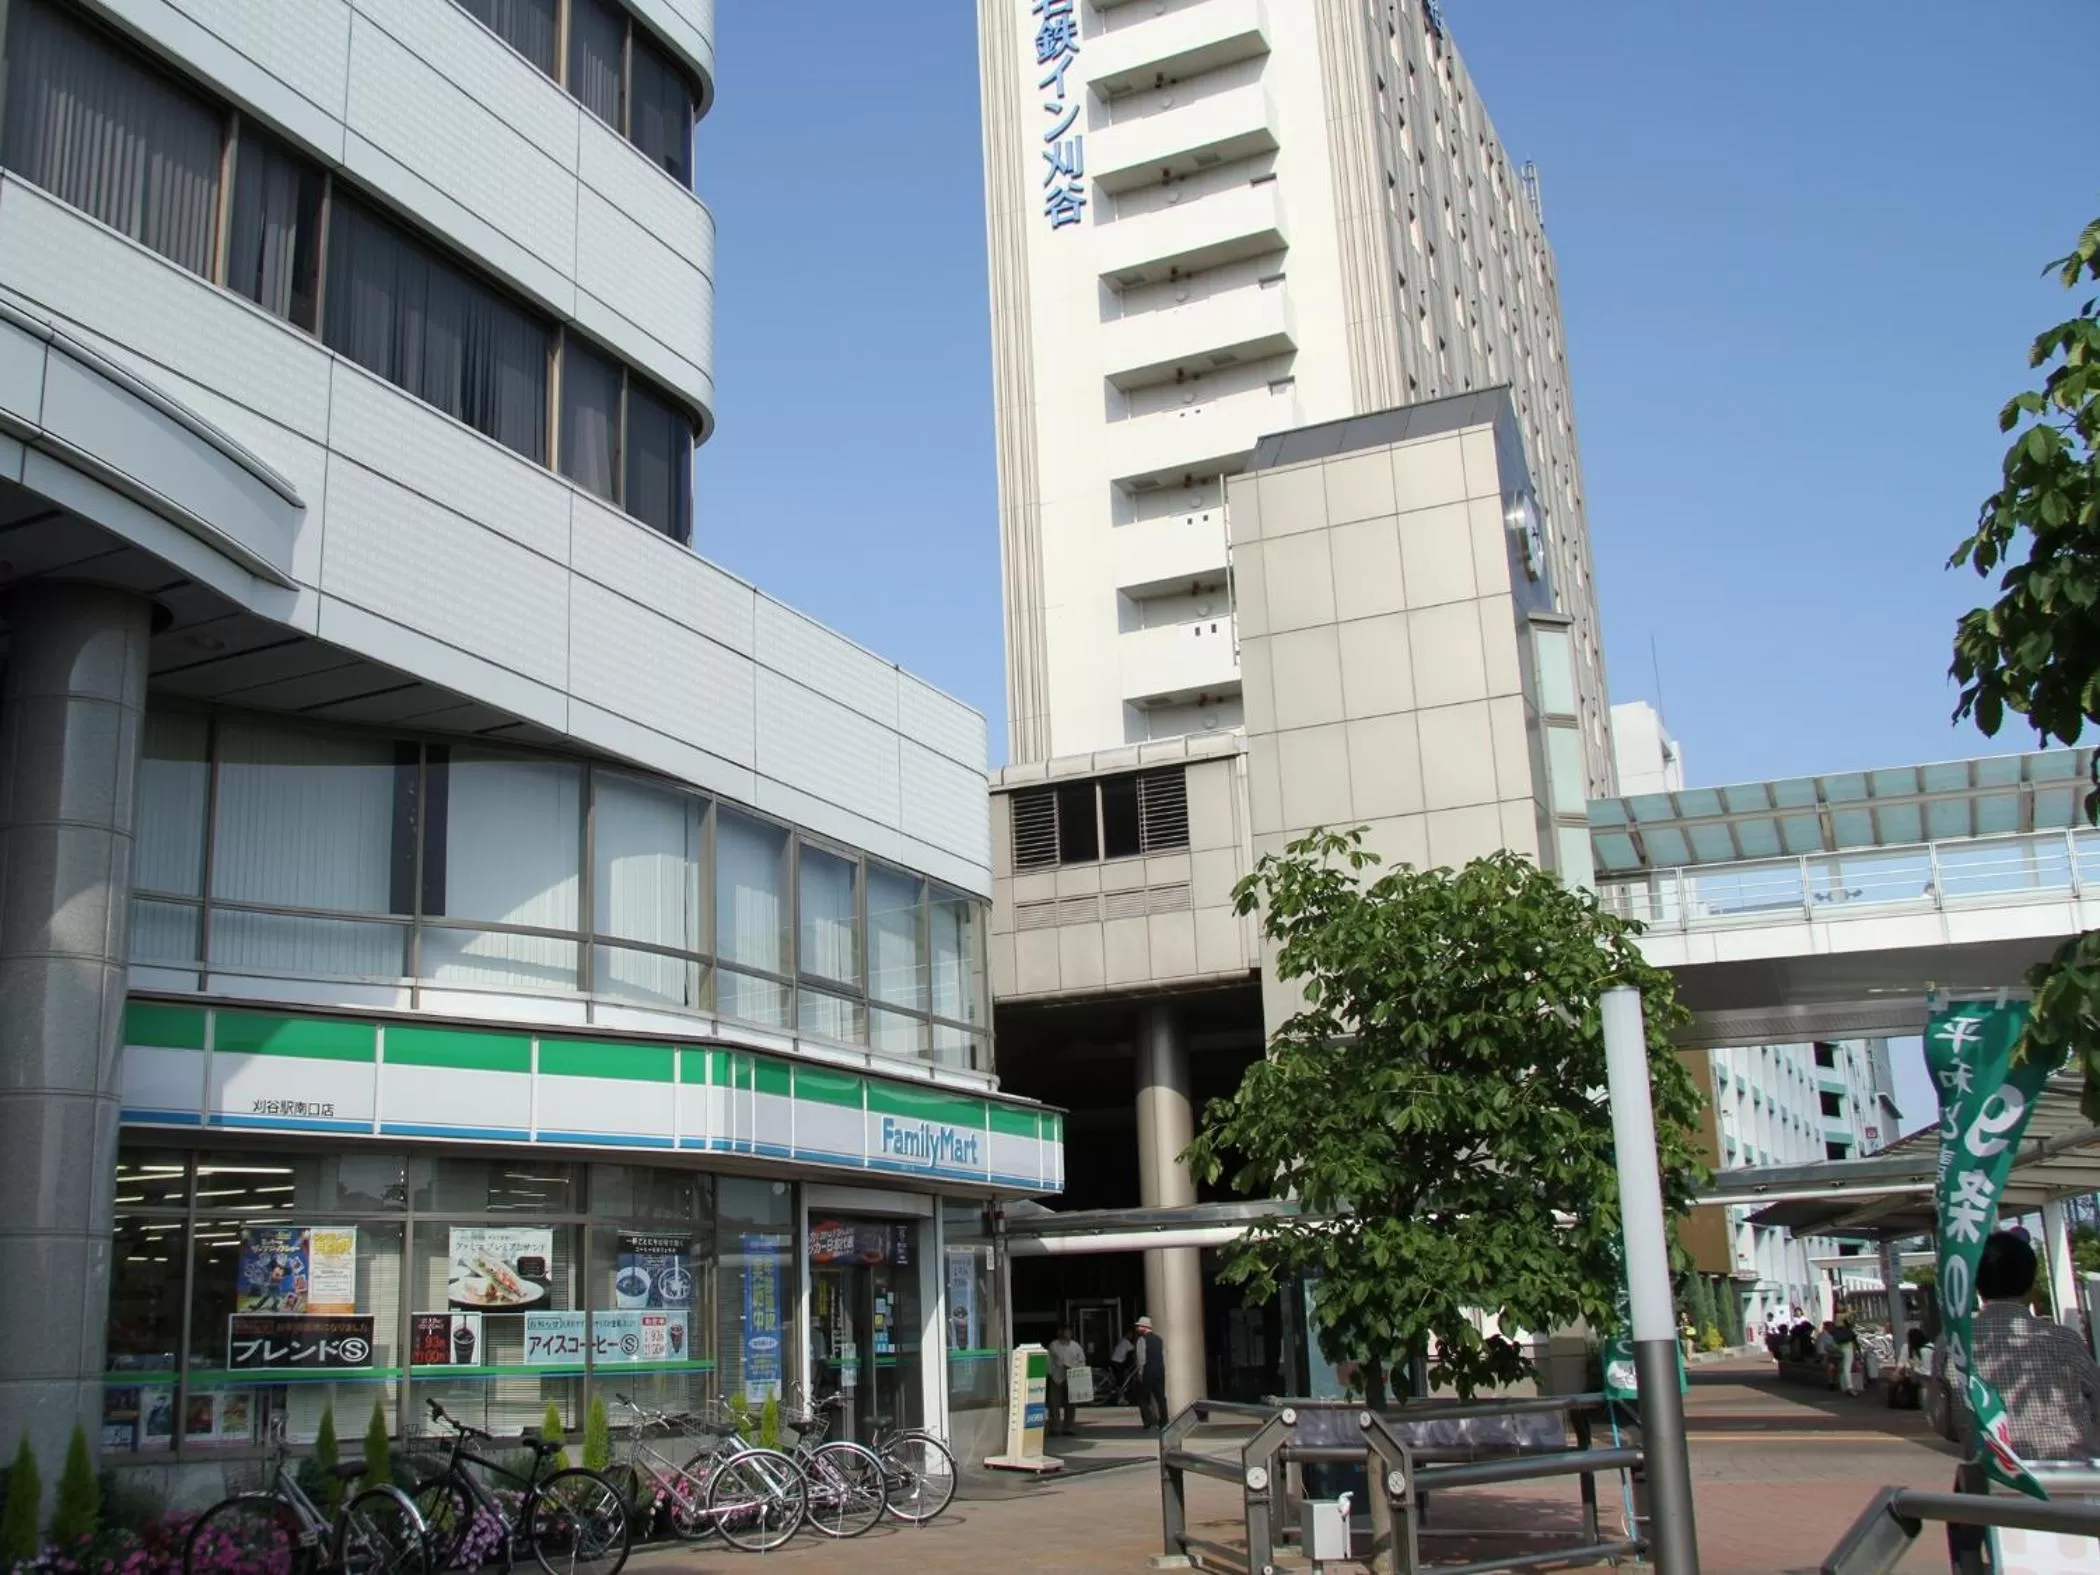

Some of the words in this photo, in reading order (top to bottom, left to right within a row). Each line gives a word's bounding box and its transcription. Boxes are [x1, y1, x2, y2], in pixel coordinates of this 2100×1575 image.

[253, 1099, 334, 1117] 刈谷駅南口店
[883, 1116, 978, 1168] FamilyMart
